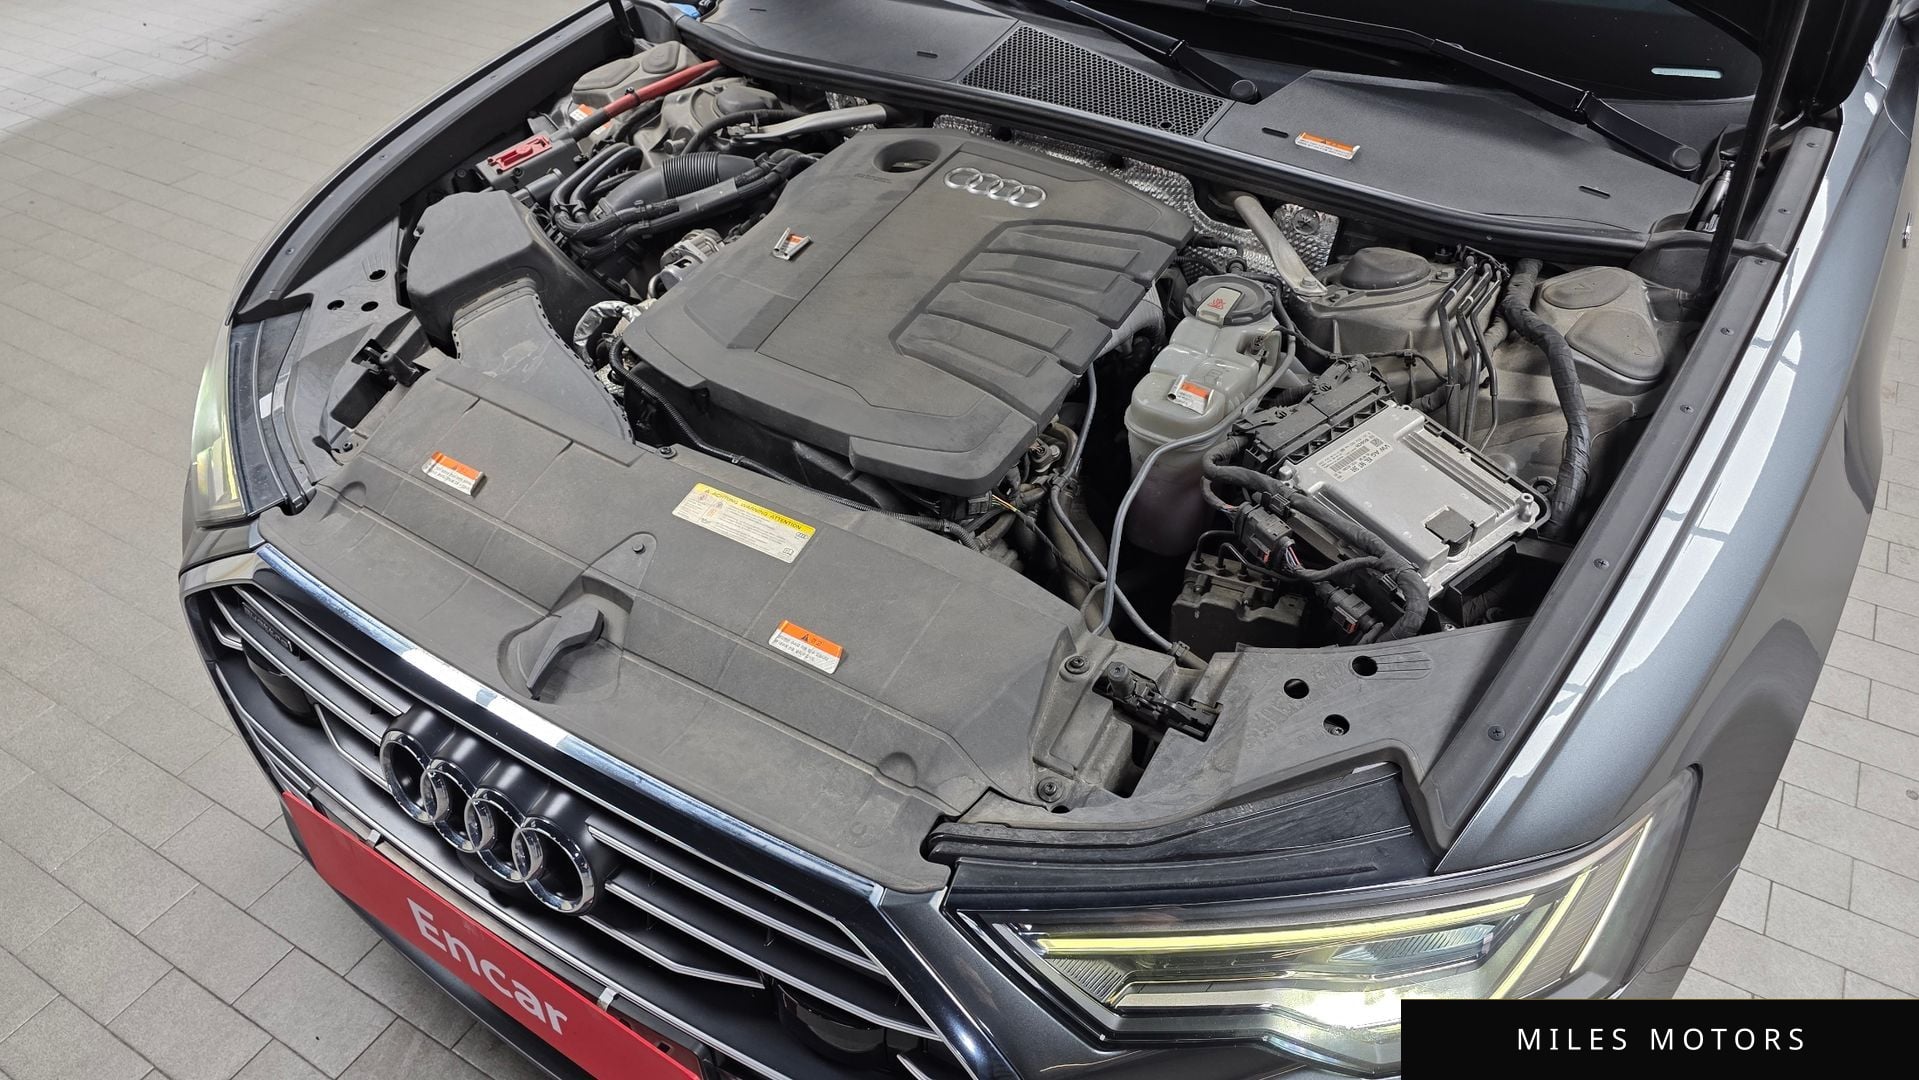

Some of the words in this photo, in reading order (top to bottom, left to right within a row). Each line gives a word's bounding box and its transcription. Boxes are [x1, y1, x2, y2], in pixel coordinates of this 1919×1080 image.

[740, 502, 768, 517] WARNING
[769, 514, 801, 530] ATTENTION
[407, 897, 568, 1036] Encar
